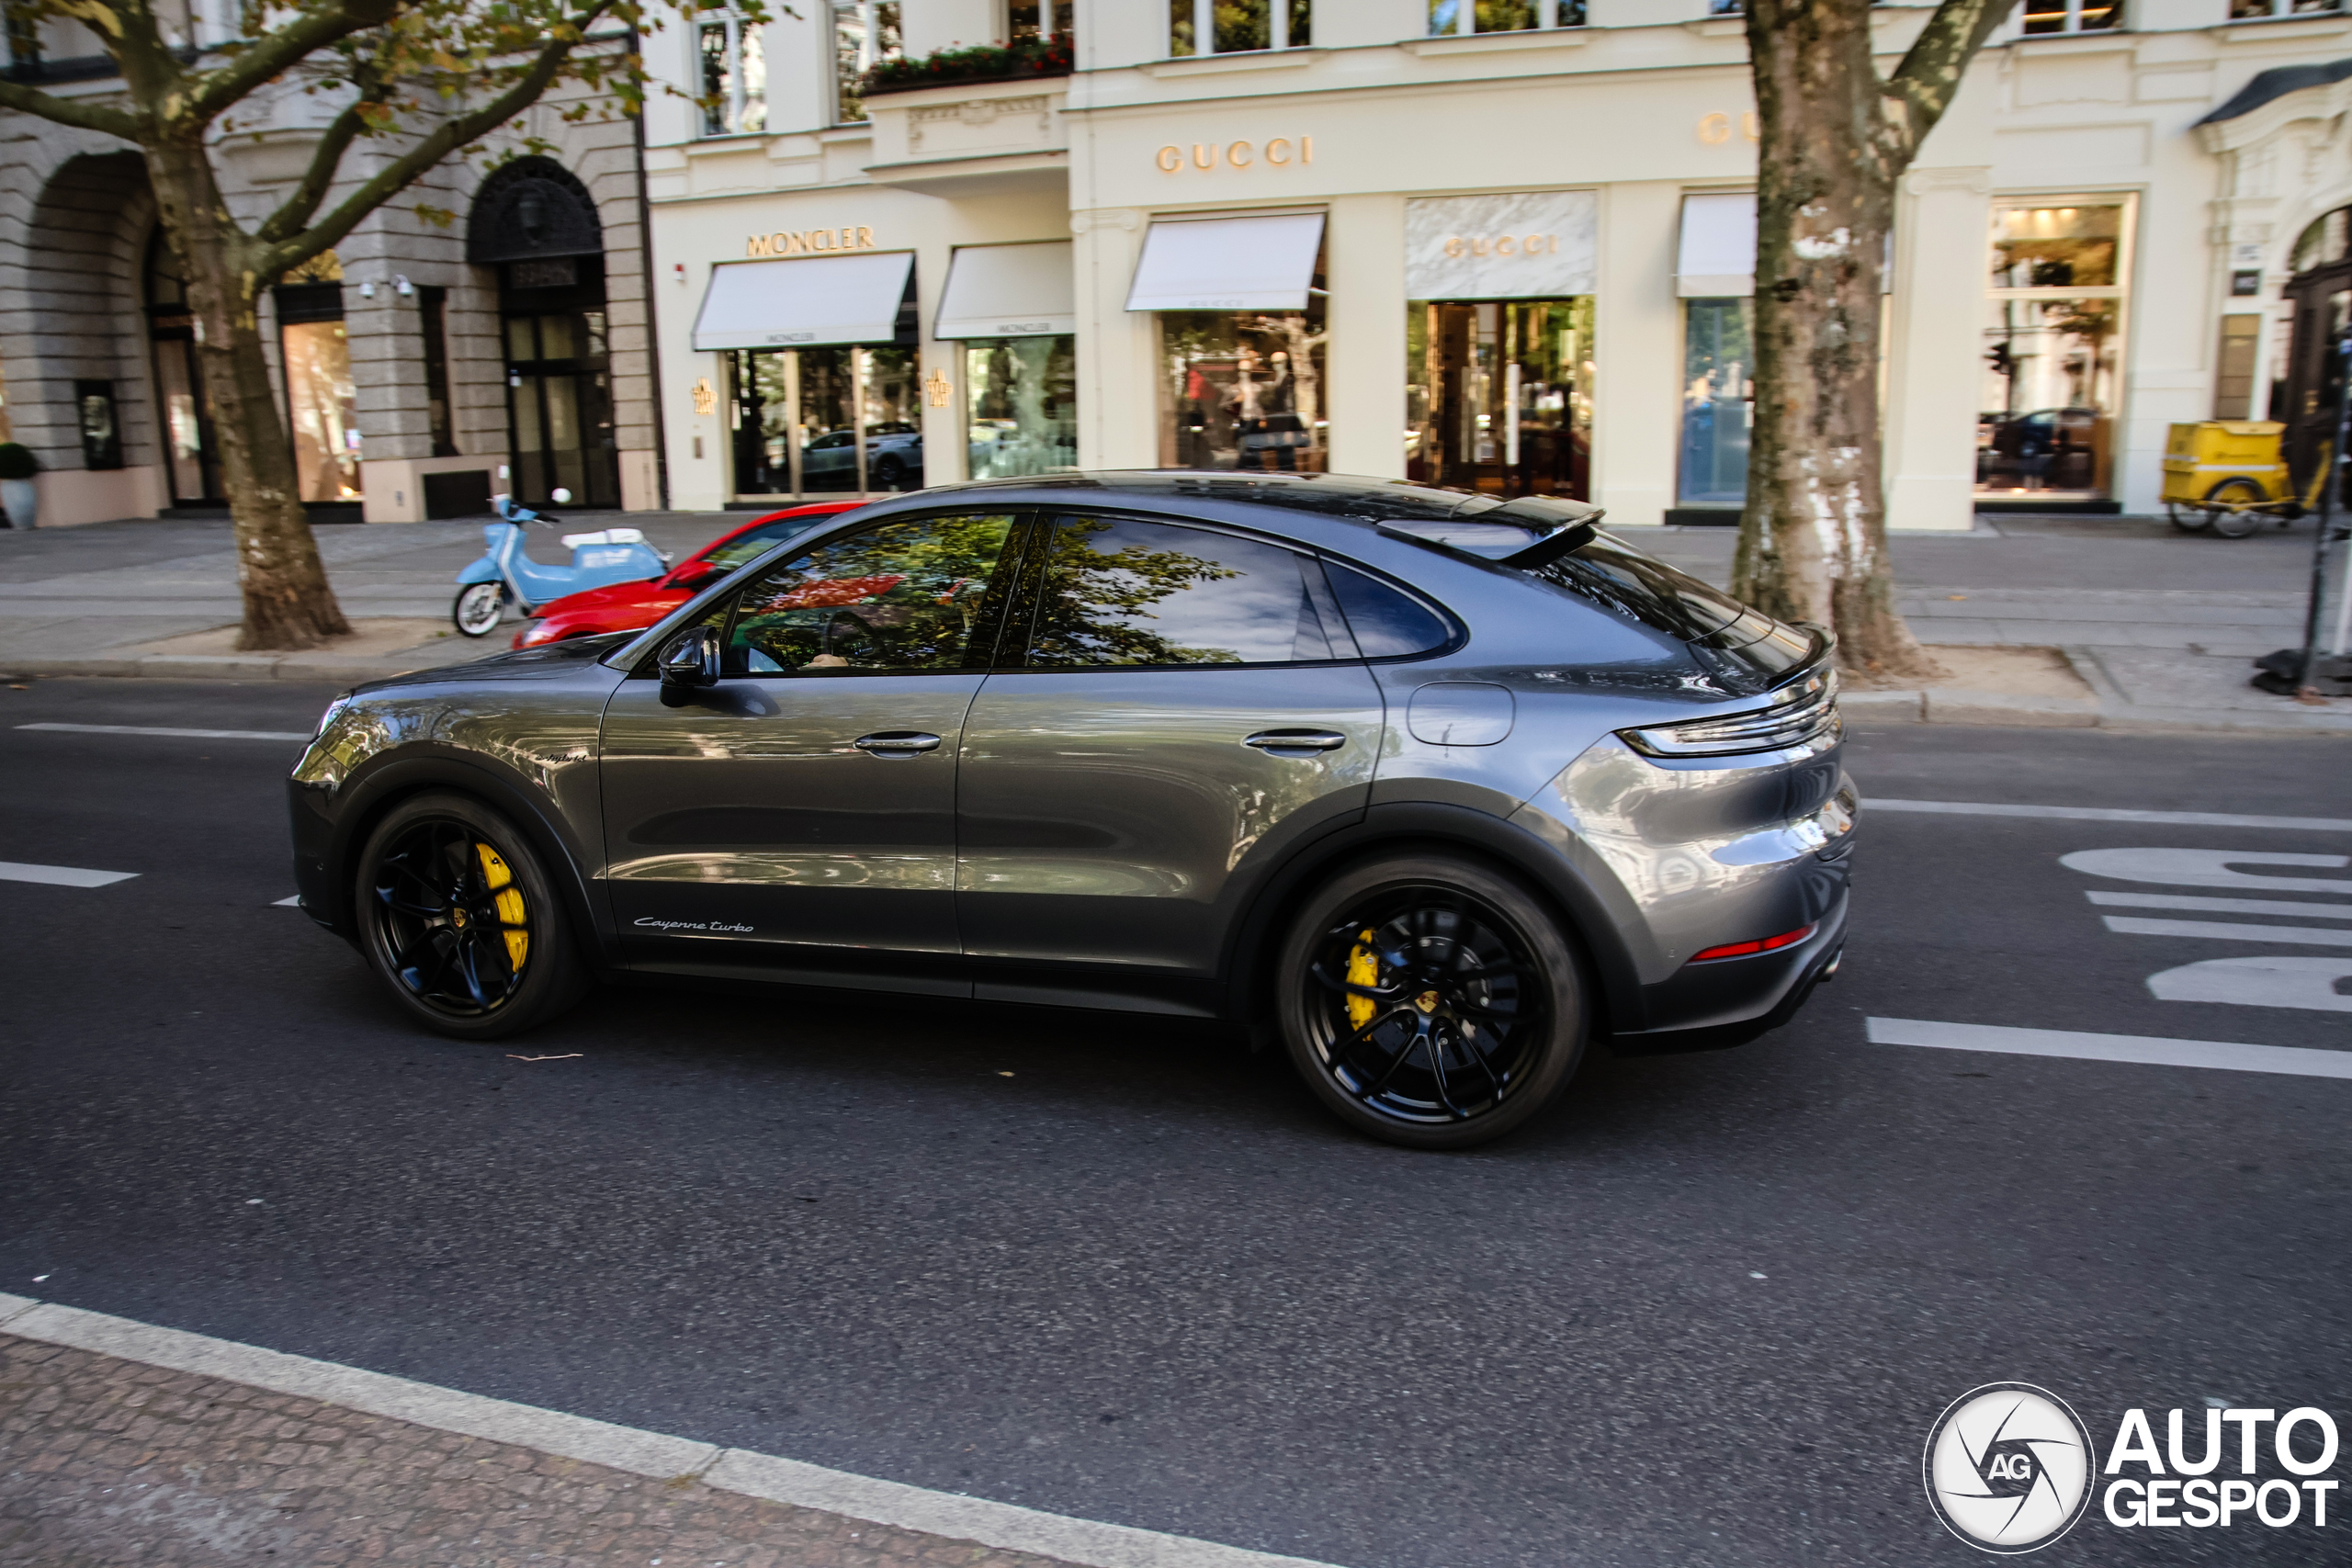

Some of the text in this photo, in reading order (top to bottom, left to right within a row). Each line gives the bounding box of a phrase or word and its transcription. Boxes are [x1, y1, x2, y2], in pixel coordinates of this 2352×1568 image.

[1155, 135, 1313, 174] GUCCI
[747, 225, 876, 257] MONCLER
[1443, 233, 1560, 259] GUCCI
[633, 917, 754, 932] Cayenne turbo
